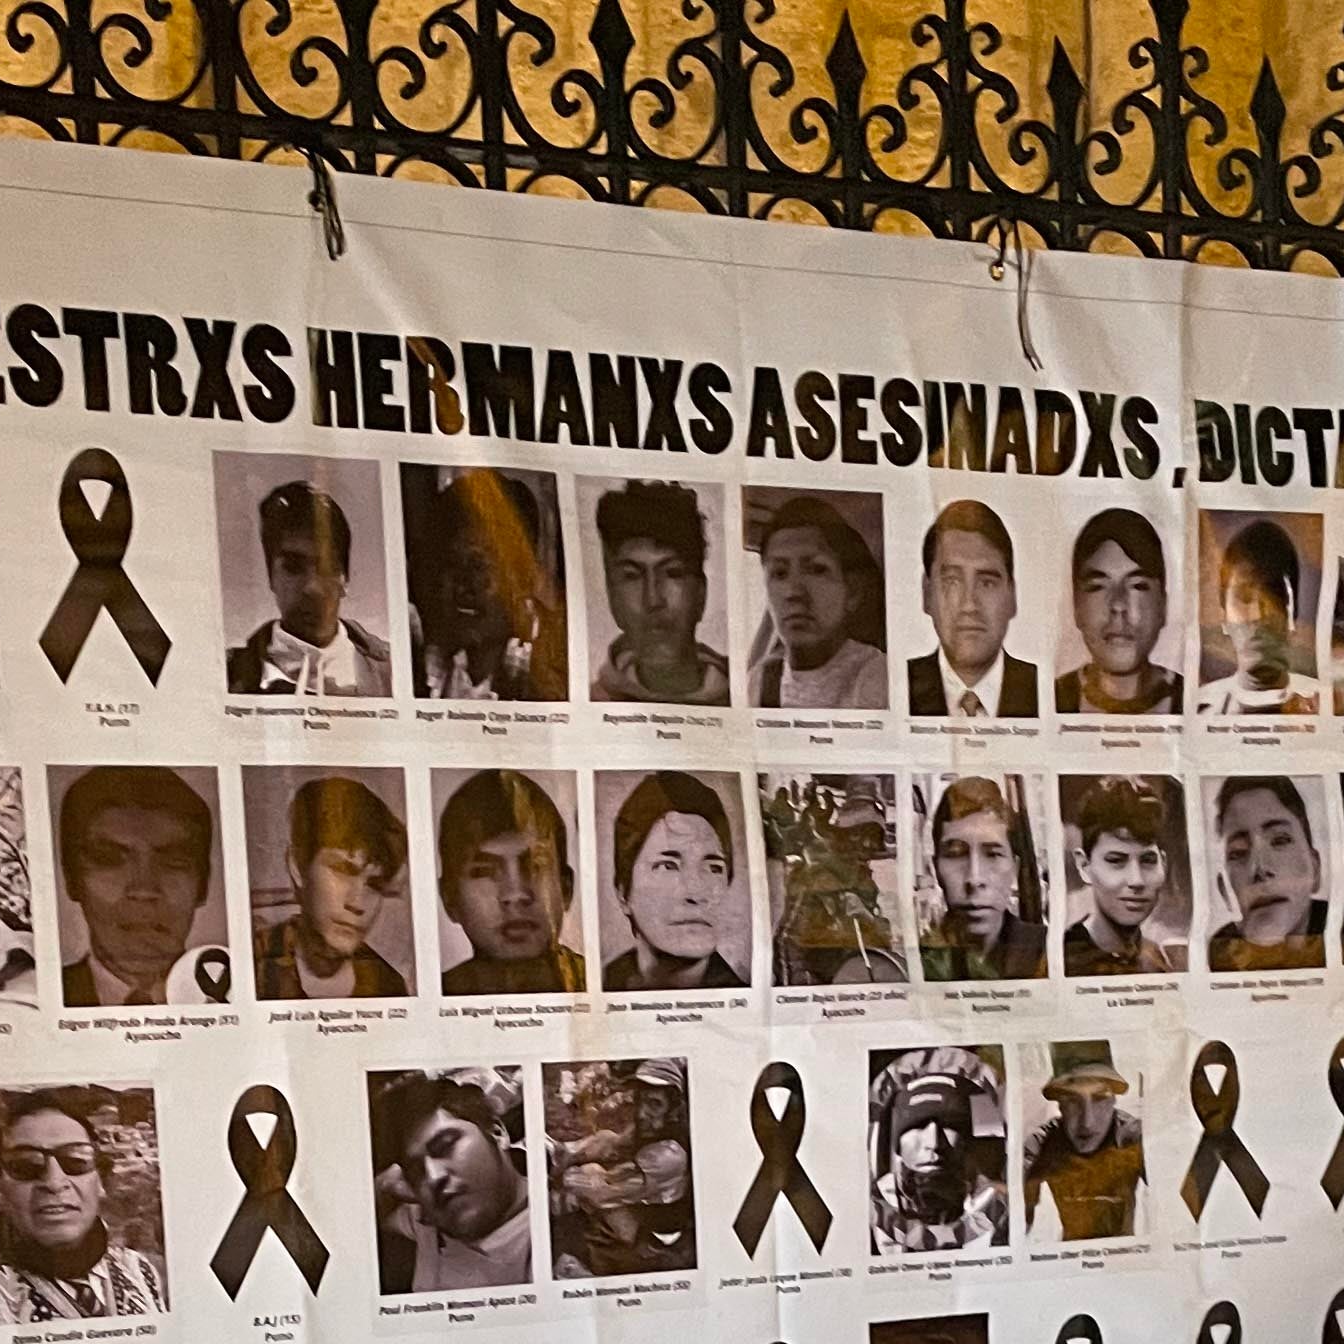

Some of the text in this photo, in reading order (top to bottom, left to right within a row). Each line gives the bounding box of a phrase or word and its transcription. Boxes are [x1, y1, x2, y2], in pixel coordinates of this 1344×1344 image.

[307, 326, 733, 456] HERMANXS
[125, 1030, 182, 1043] Ayacucho
[316, 1024, 368, 1036] Ayacucho
